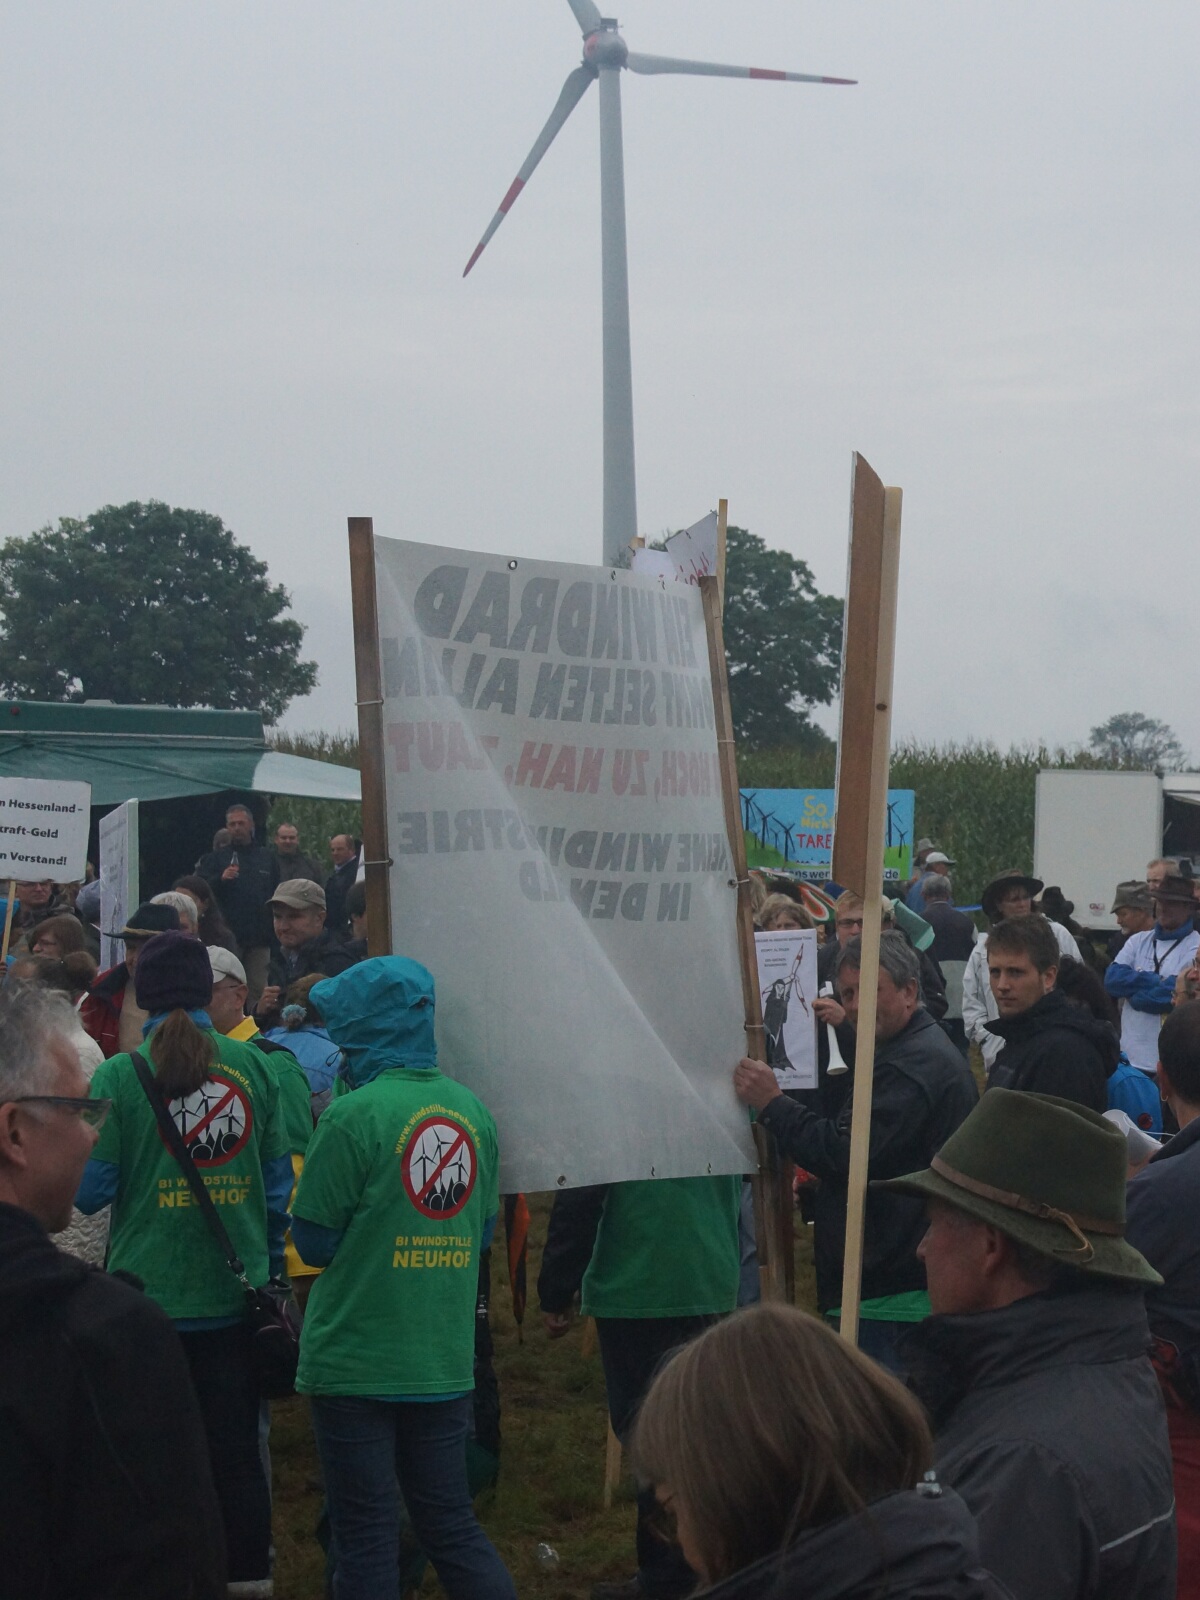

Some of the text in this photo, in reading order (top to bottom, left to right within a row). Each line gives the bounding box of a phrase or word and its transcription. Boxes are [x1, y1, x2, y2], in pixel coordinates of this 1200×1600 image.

[9, 799, 76, 813] Hessenland
[803, 795, 828, 817] So
[10, 852, 67, 866] Verstand!
[158, 1179, 172, 1189] BI
[395, 1236, 472, 1248] BI WINDSTILLE
[392, 1250, 472, 1269] NEUHOF
